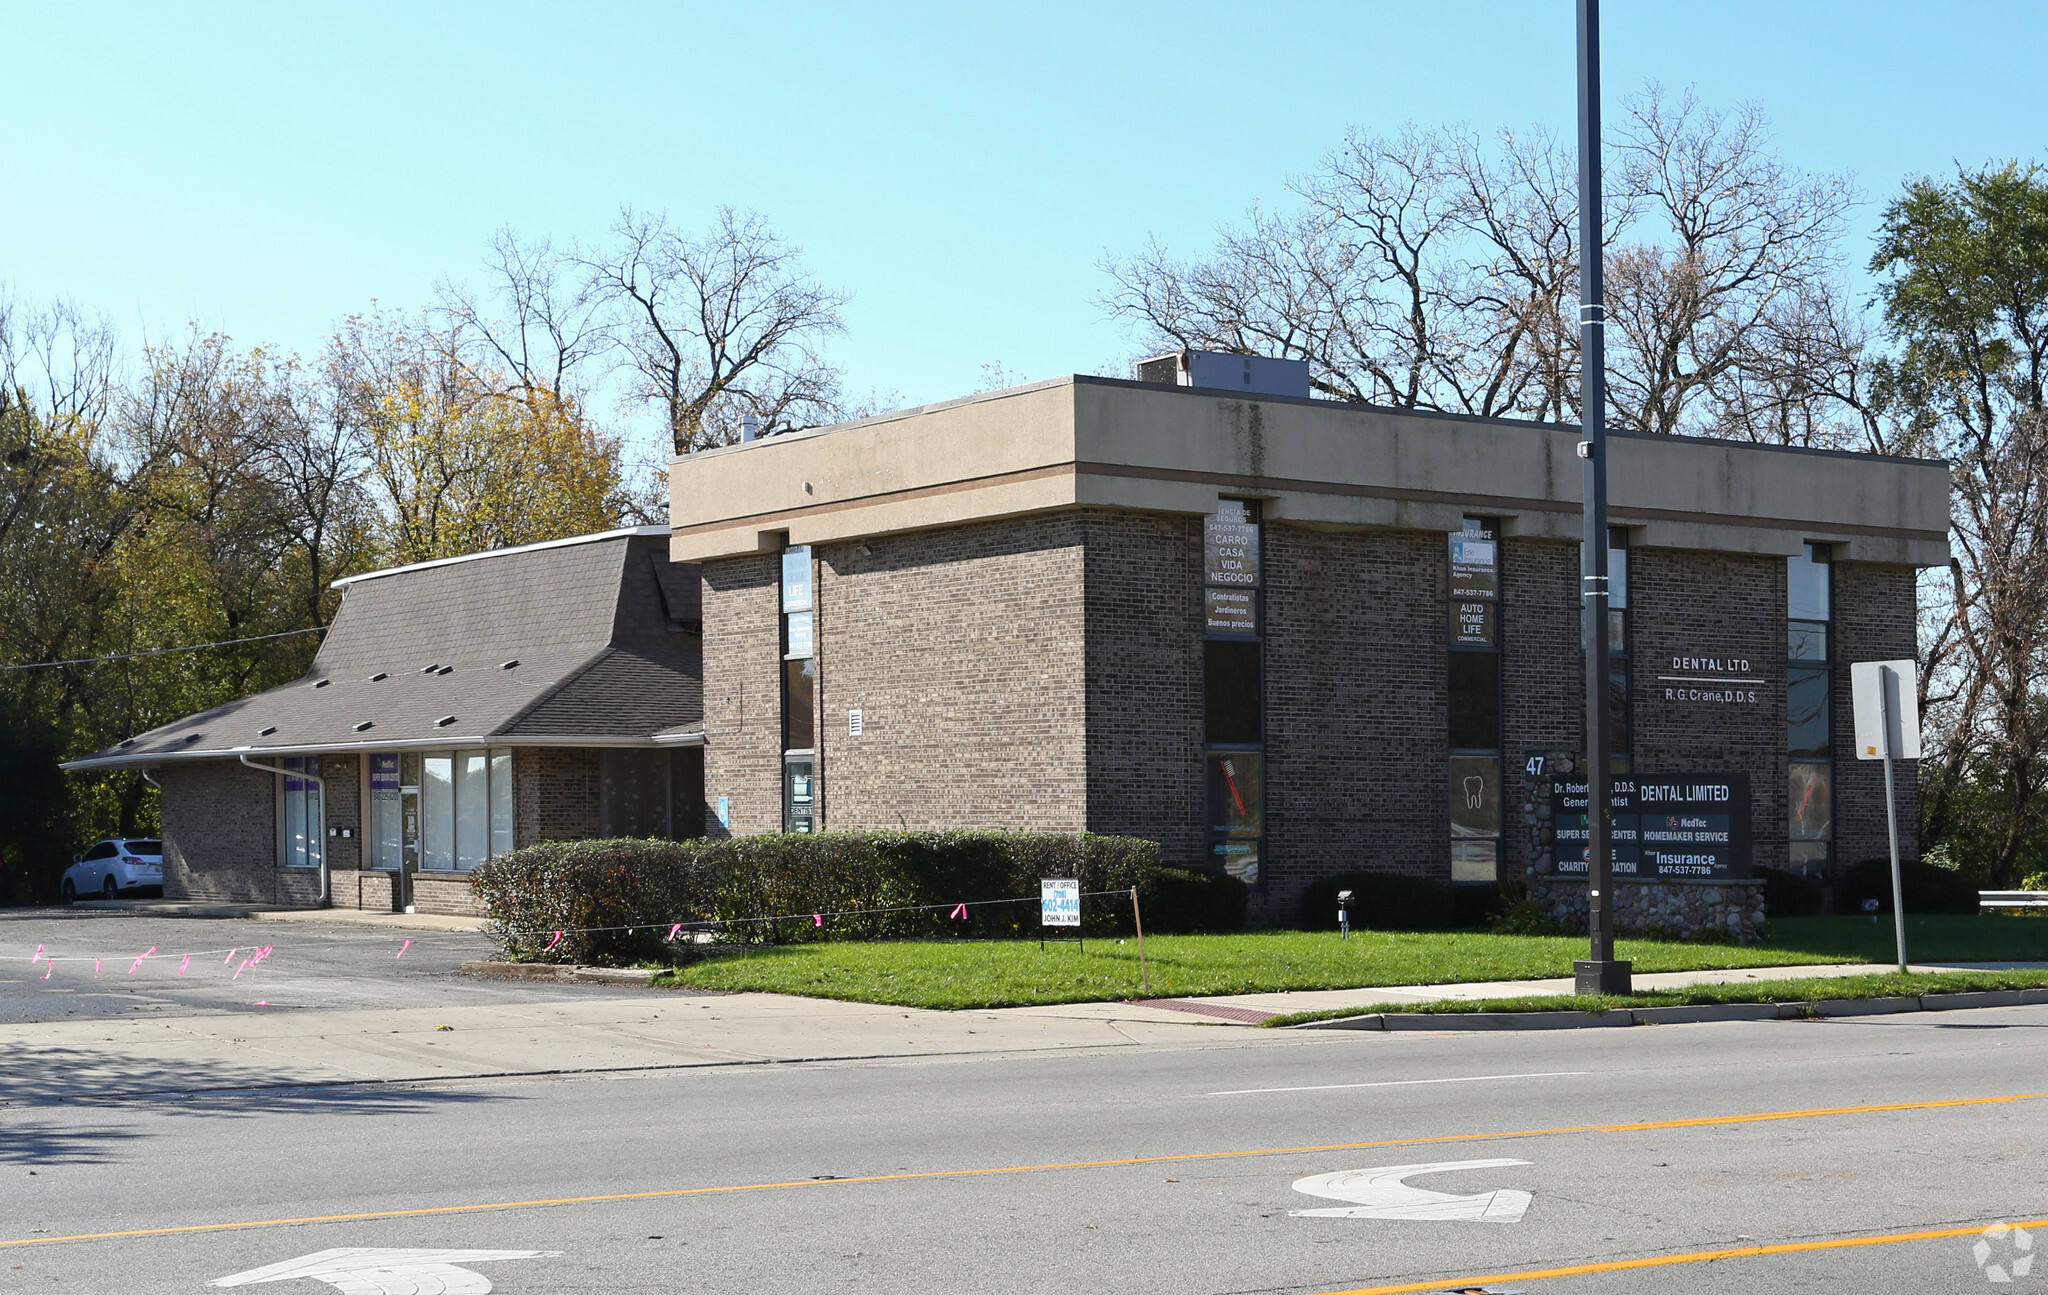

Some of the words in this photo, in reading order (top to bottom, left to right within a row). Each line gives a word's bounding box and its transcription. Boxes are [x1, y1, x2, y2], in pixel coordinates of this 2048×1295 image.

[1216, 515, 1247, 523] SEGUROS
[1215, 534, 1248, 545] CARRO
[1219, 547, 1245, 558] CASA
[1221, 560, 1243, 570] VIDA
[1211, 572, 1253, 583] NEGOCIO
[788, 583, 804, 597] LIFE
[1211, 592, 1249, 602] Contratistas
[1214, 605, 1247, 615] Jardineros
[1460, 604, 1484, 613] AUTO
[1207, 618, 1231, 627] Buenos
[1231, 619, 1254, 629] precios
[1460, 614, 1484, 623] HOME
[1463, 625, 1481, 634] LIFE
[1673, 657, 1723, 671] DENTAL
[1727, 659, 1751, 672] LTD.
[1526, 756, 1544, 775] 47
[1554, 783, 1565, 793] Dr.
[1566, 782, 1590, 793] Robert
[1614, 781, 1637, 793] D.D.S.
[1641, 785, 1684, 801] DENTAL
[1686, 785, 1729, 801] LIMITED
[1563, 797, 1589, 807] Gener
[1681, 817, 1707, 828] MedTec
[1556, 829, 1580, 839] SUPER
[1611, 830, 1637, 840] ENTER
[1644, 831, 1693, 841] HOMEMAKER
[1695, 832, 1729, 842] SERVICE
[1656, 851, 1715, 865] Insurance
[1558, 861, 1590, 872] CHARITY
[1658, 865, 1711, 875] 847-537-7786
[1043, 914, 1060, 922] JOHN
[1061, 914, 1067, 922] J.
[1067, 914, 1079, 922] KIM
